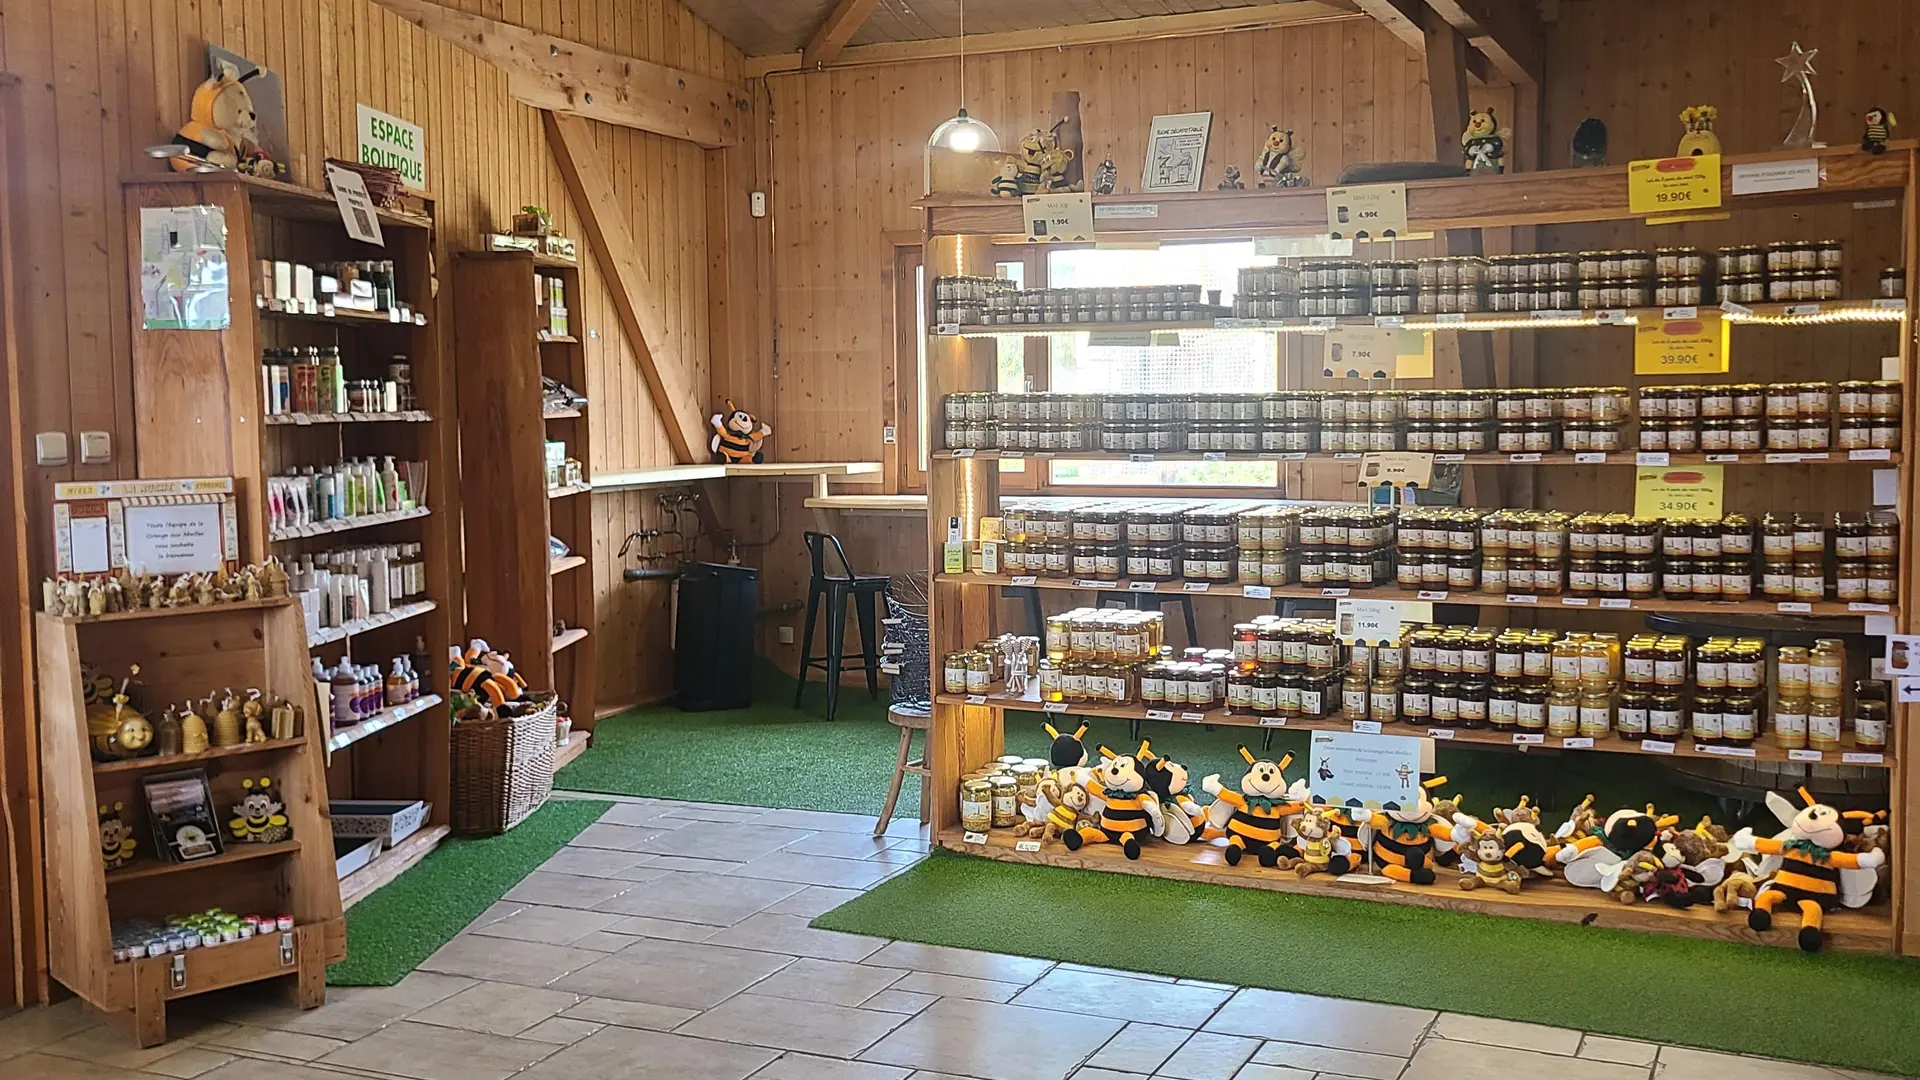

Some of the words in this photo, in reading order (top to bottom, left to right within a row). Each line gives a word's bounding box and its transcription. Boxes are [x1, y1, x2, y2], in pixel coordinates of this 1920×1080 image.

[371, 117, 413, 151] ESPACE
[362, 144, 422, 182] BOUTIQUE
[1656, 191, 1692, 203] 19.90€
[1660, 354, 1698, 364] 39.90€
[1660, 502, 1698, 510] 34.90€
